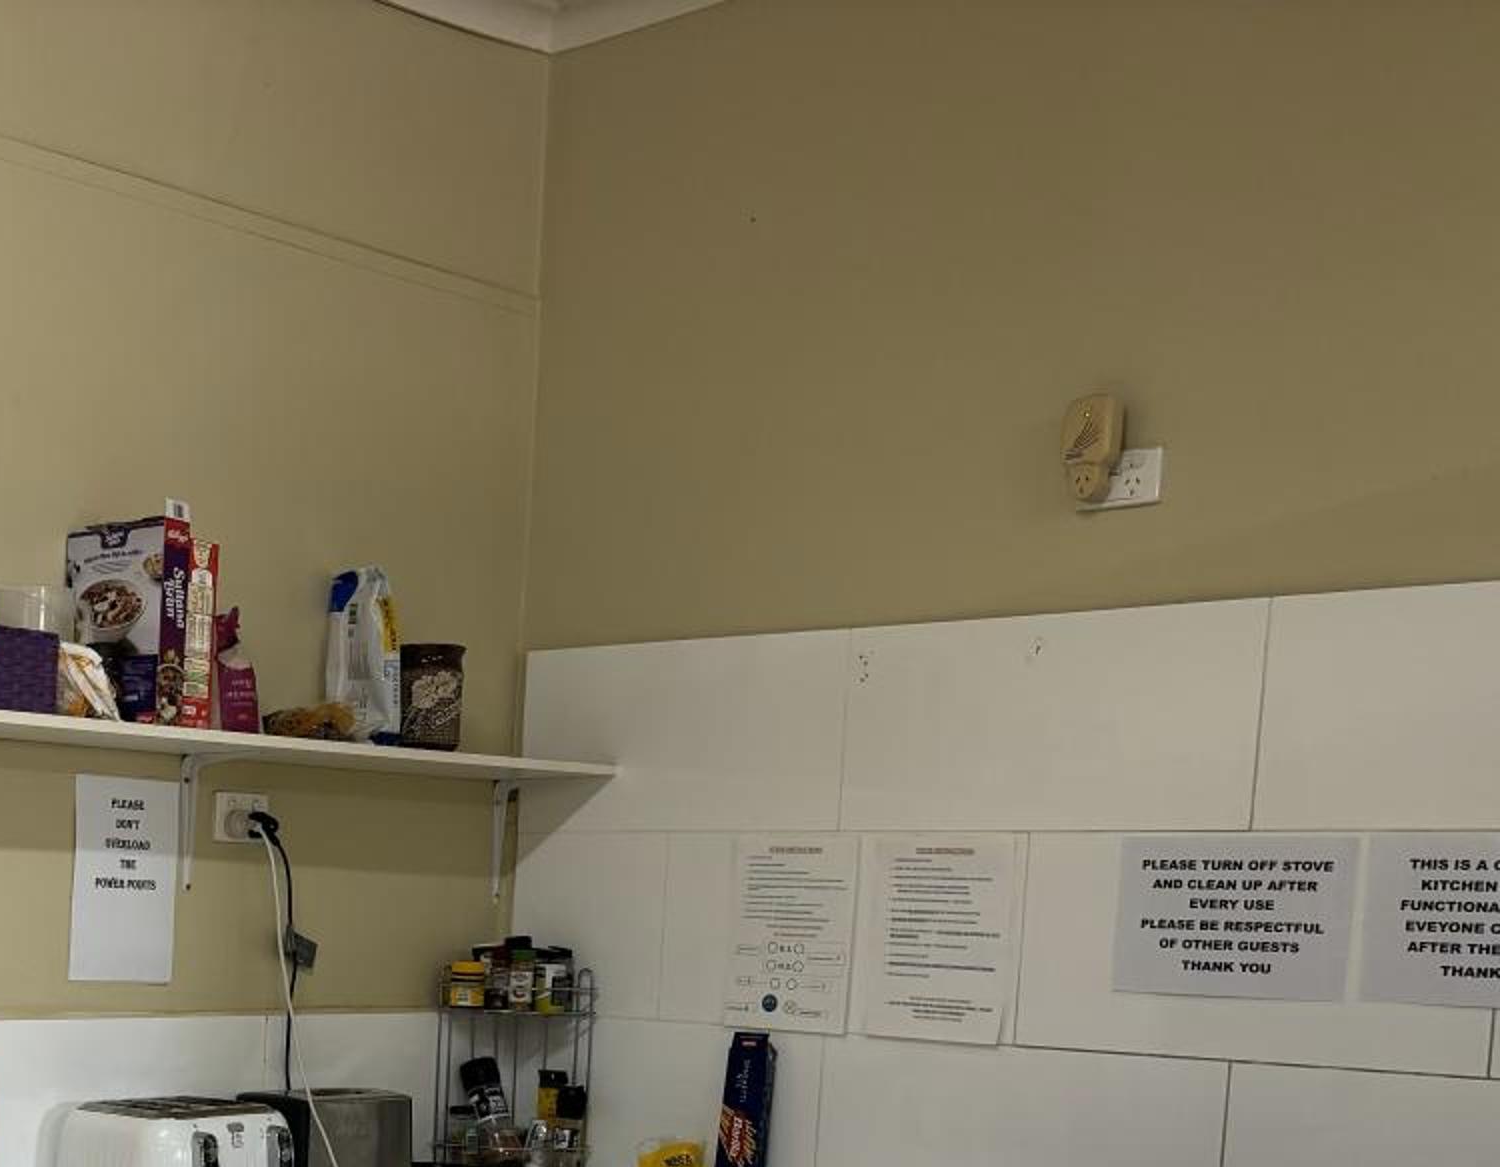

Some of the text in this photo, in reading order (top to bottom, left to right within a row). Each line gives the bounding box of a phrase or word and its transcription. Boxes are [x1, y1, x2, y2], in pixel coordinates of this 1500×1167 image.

[111, 798, 145, 811] PLEASE
[1142, 859, 1334, 873] PLEASE TURN OFF STOVE
[1410, 858, 1449, 871] THIS
[1453, 859, 1471, 871] IS
[1476, 859, 1488, 871] A
[95, 876, 125, 889] POWER
[1152, 878, 1318, 892] AND CLEAN UP AFTER
[1421, 879, 1498, 892] KITCHEN
[1189, 898, 1275, 911] EVERY USE
[1140, 918, 1325, 934] PLEASE BE RESPECTFUL
[1405, 920, 1485, 935] EVEYONE
[1159, 938, 1300, 953] OF OTHER GUESTS
[1407, 941, 1462, 954] AFTER
[1181, 959, 1271, 974] THANK YOU
[1440, 965, 1500, 979] THANK
